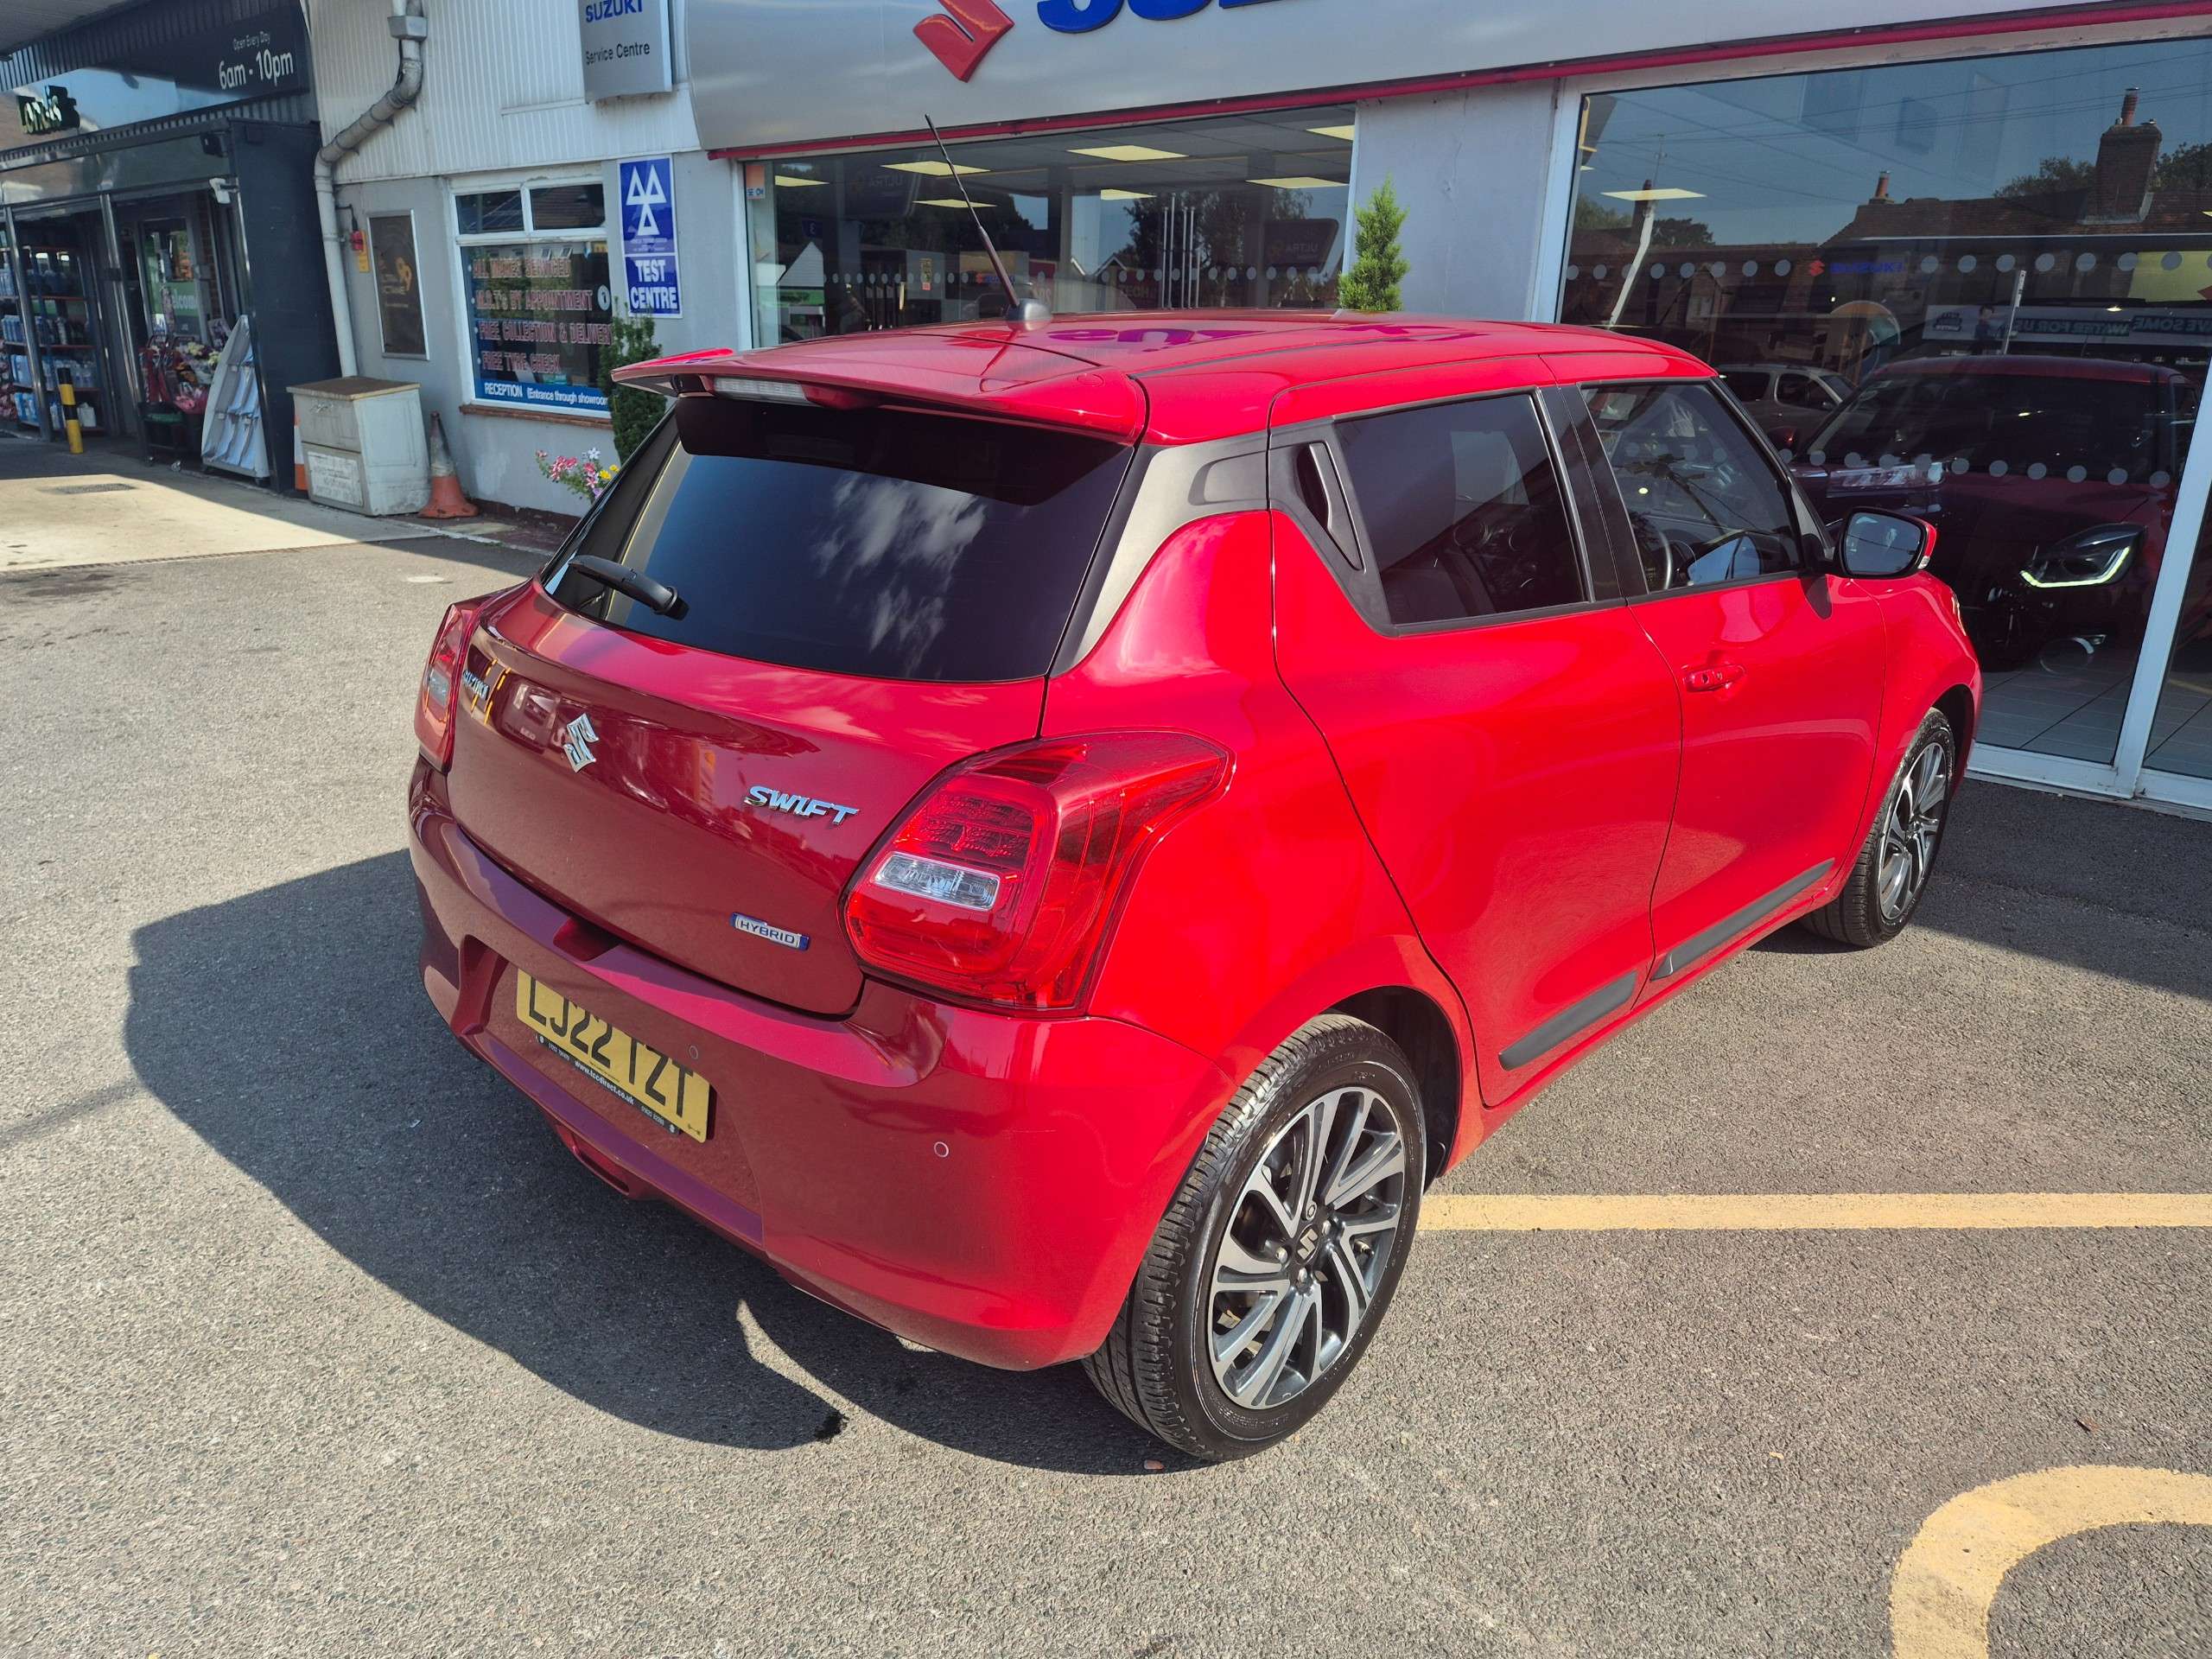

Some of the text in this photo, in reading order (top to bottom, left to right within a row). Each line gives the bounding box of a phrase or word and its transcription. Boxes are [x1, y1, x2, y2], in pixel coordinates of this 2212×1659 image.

[585, 0, 643, 23] SUZUKI
[586, 42, 650, 65] Service Centre
[219, 60, 247, 90] 6am
[256, 48, 294, 87] 10pm
[473, 258, 489, 278] ALL
[635, 259, 665, 283] TEST
[510, 289, 522, 310] BY
[524, 289, 593, 311] APPOINTMENT
[630, 286, 677, 309] CENTRE
[479, 321, 501, 340] FREE
[502, 321, 557, 343] COLLECTION
[559, 322, 568, 343] &
[481, 350, 560, 373] FREE TYRE CHECK
[484, 382, 523, 397] RECEPTION
[554, 390, 577, 404] through
[744, 785, 861, 826] SWIFT
[740, 919, 796, 944] HYBRID
[528, 976, 612, 1069] LJ22
[574, 1060, 634, 1105] www.tccdirect.co.uk
